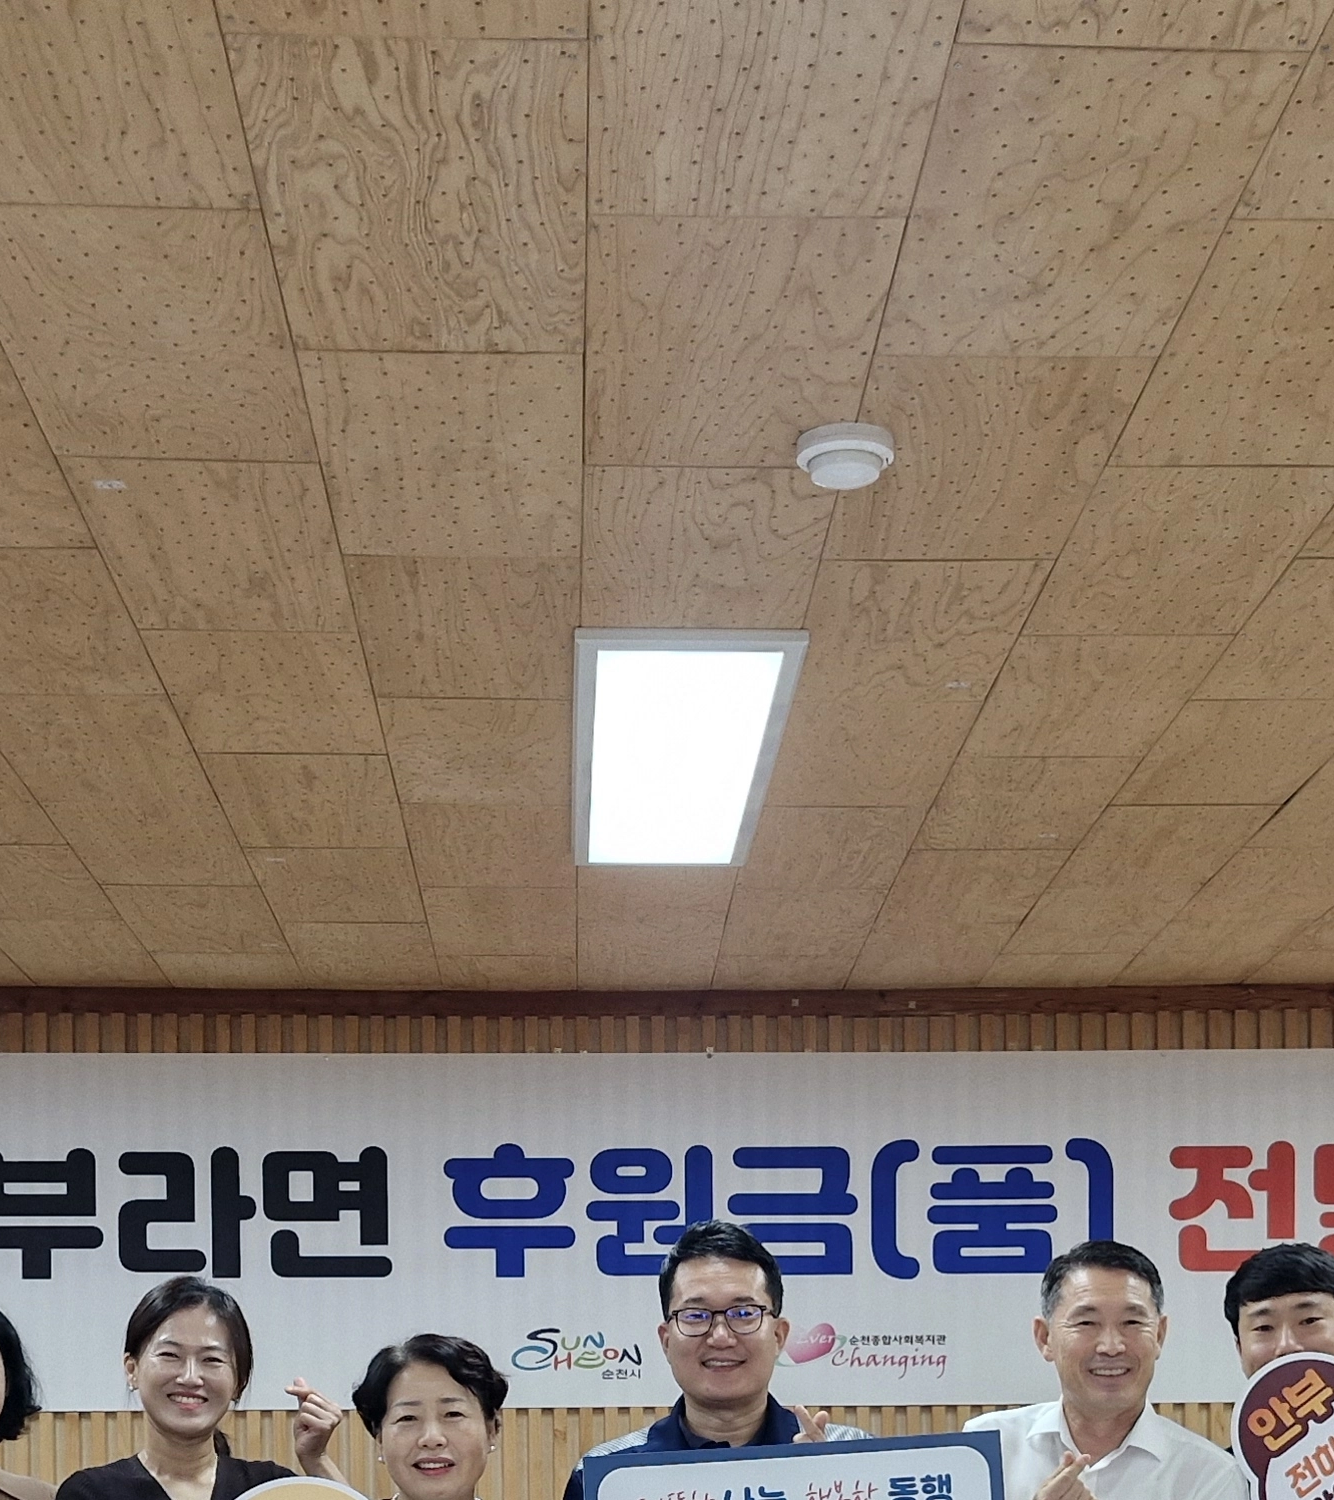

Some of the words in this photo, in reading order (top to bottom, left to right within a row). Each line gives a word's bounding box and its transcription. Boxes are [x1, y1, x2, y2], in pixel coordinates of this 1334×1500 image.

[443, 1138, 1113, 1279] 후원금(품)
[849, 1334, 947, 1347] 순천종합사회복지관
[602, 1369, 641, 1380] 순천시
[832, 1347, 947, 1380] Changing
[1247, 1368, 1334, 1452] 안부
